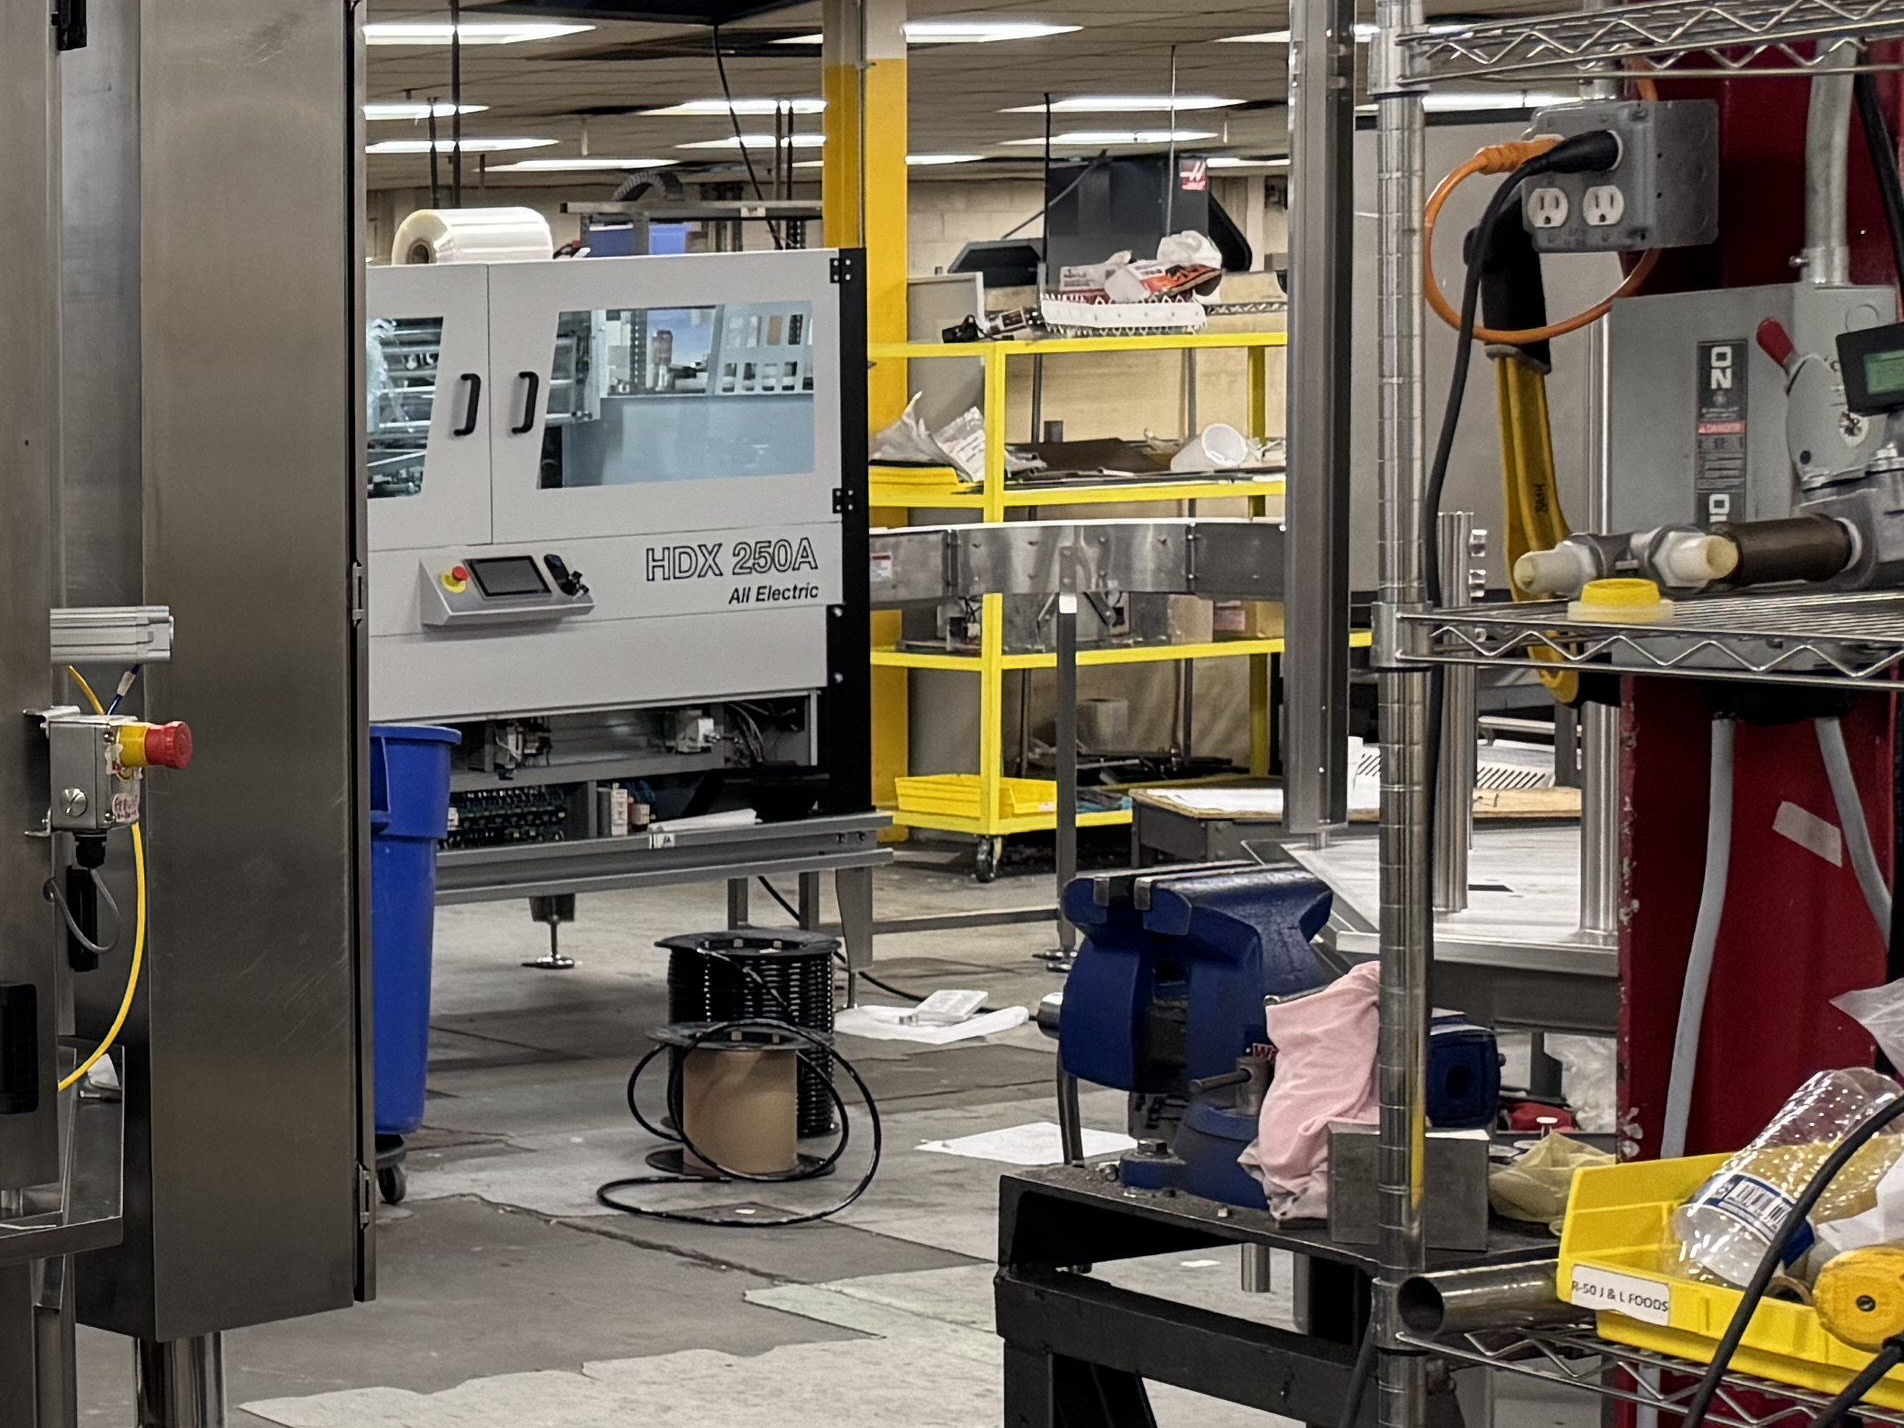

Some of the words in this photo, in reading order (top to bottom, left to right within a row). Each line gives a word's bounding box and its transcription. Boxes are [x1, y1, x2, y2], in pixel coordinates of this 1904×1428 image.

[1710, 346, 1733, 390] ON
[646, 542, 724, 582] HDX
[731, 536, 819, 576] 250A
[728, 587, 751, 605] All
[755, 582, 819, 603] Electric
[1607, 1288, 1616, 1300] &
[1619, 1291, 1625, 1303] L
[1628, 1293, 1669, 1313] FOODS
